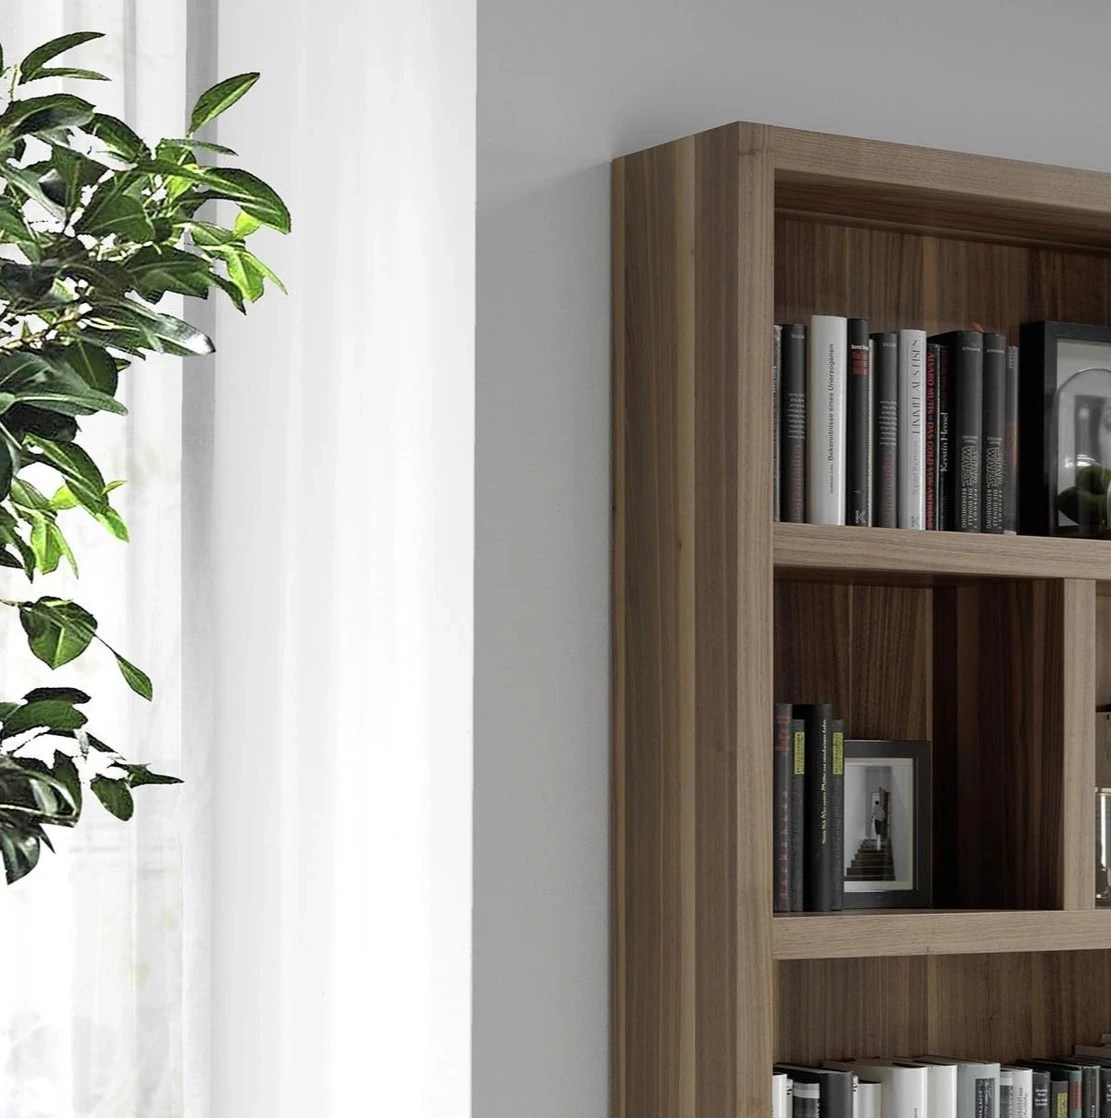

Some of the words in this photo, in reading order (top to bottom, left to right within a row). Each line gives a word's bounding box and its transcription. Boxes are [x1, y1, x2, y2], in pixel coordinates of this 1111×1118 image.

[828, 343, 836, 391] Unerzogenen
[827, 392, 835, 412] eines
[827, 413, 835, 461] Bekenntnisse
